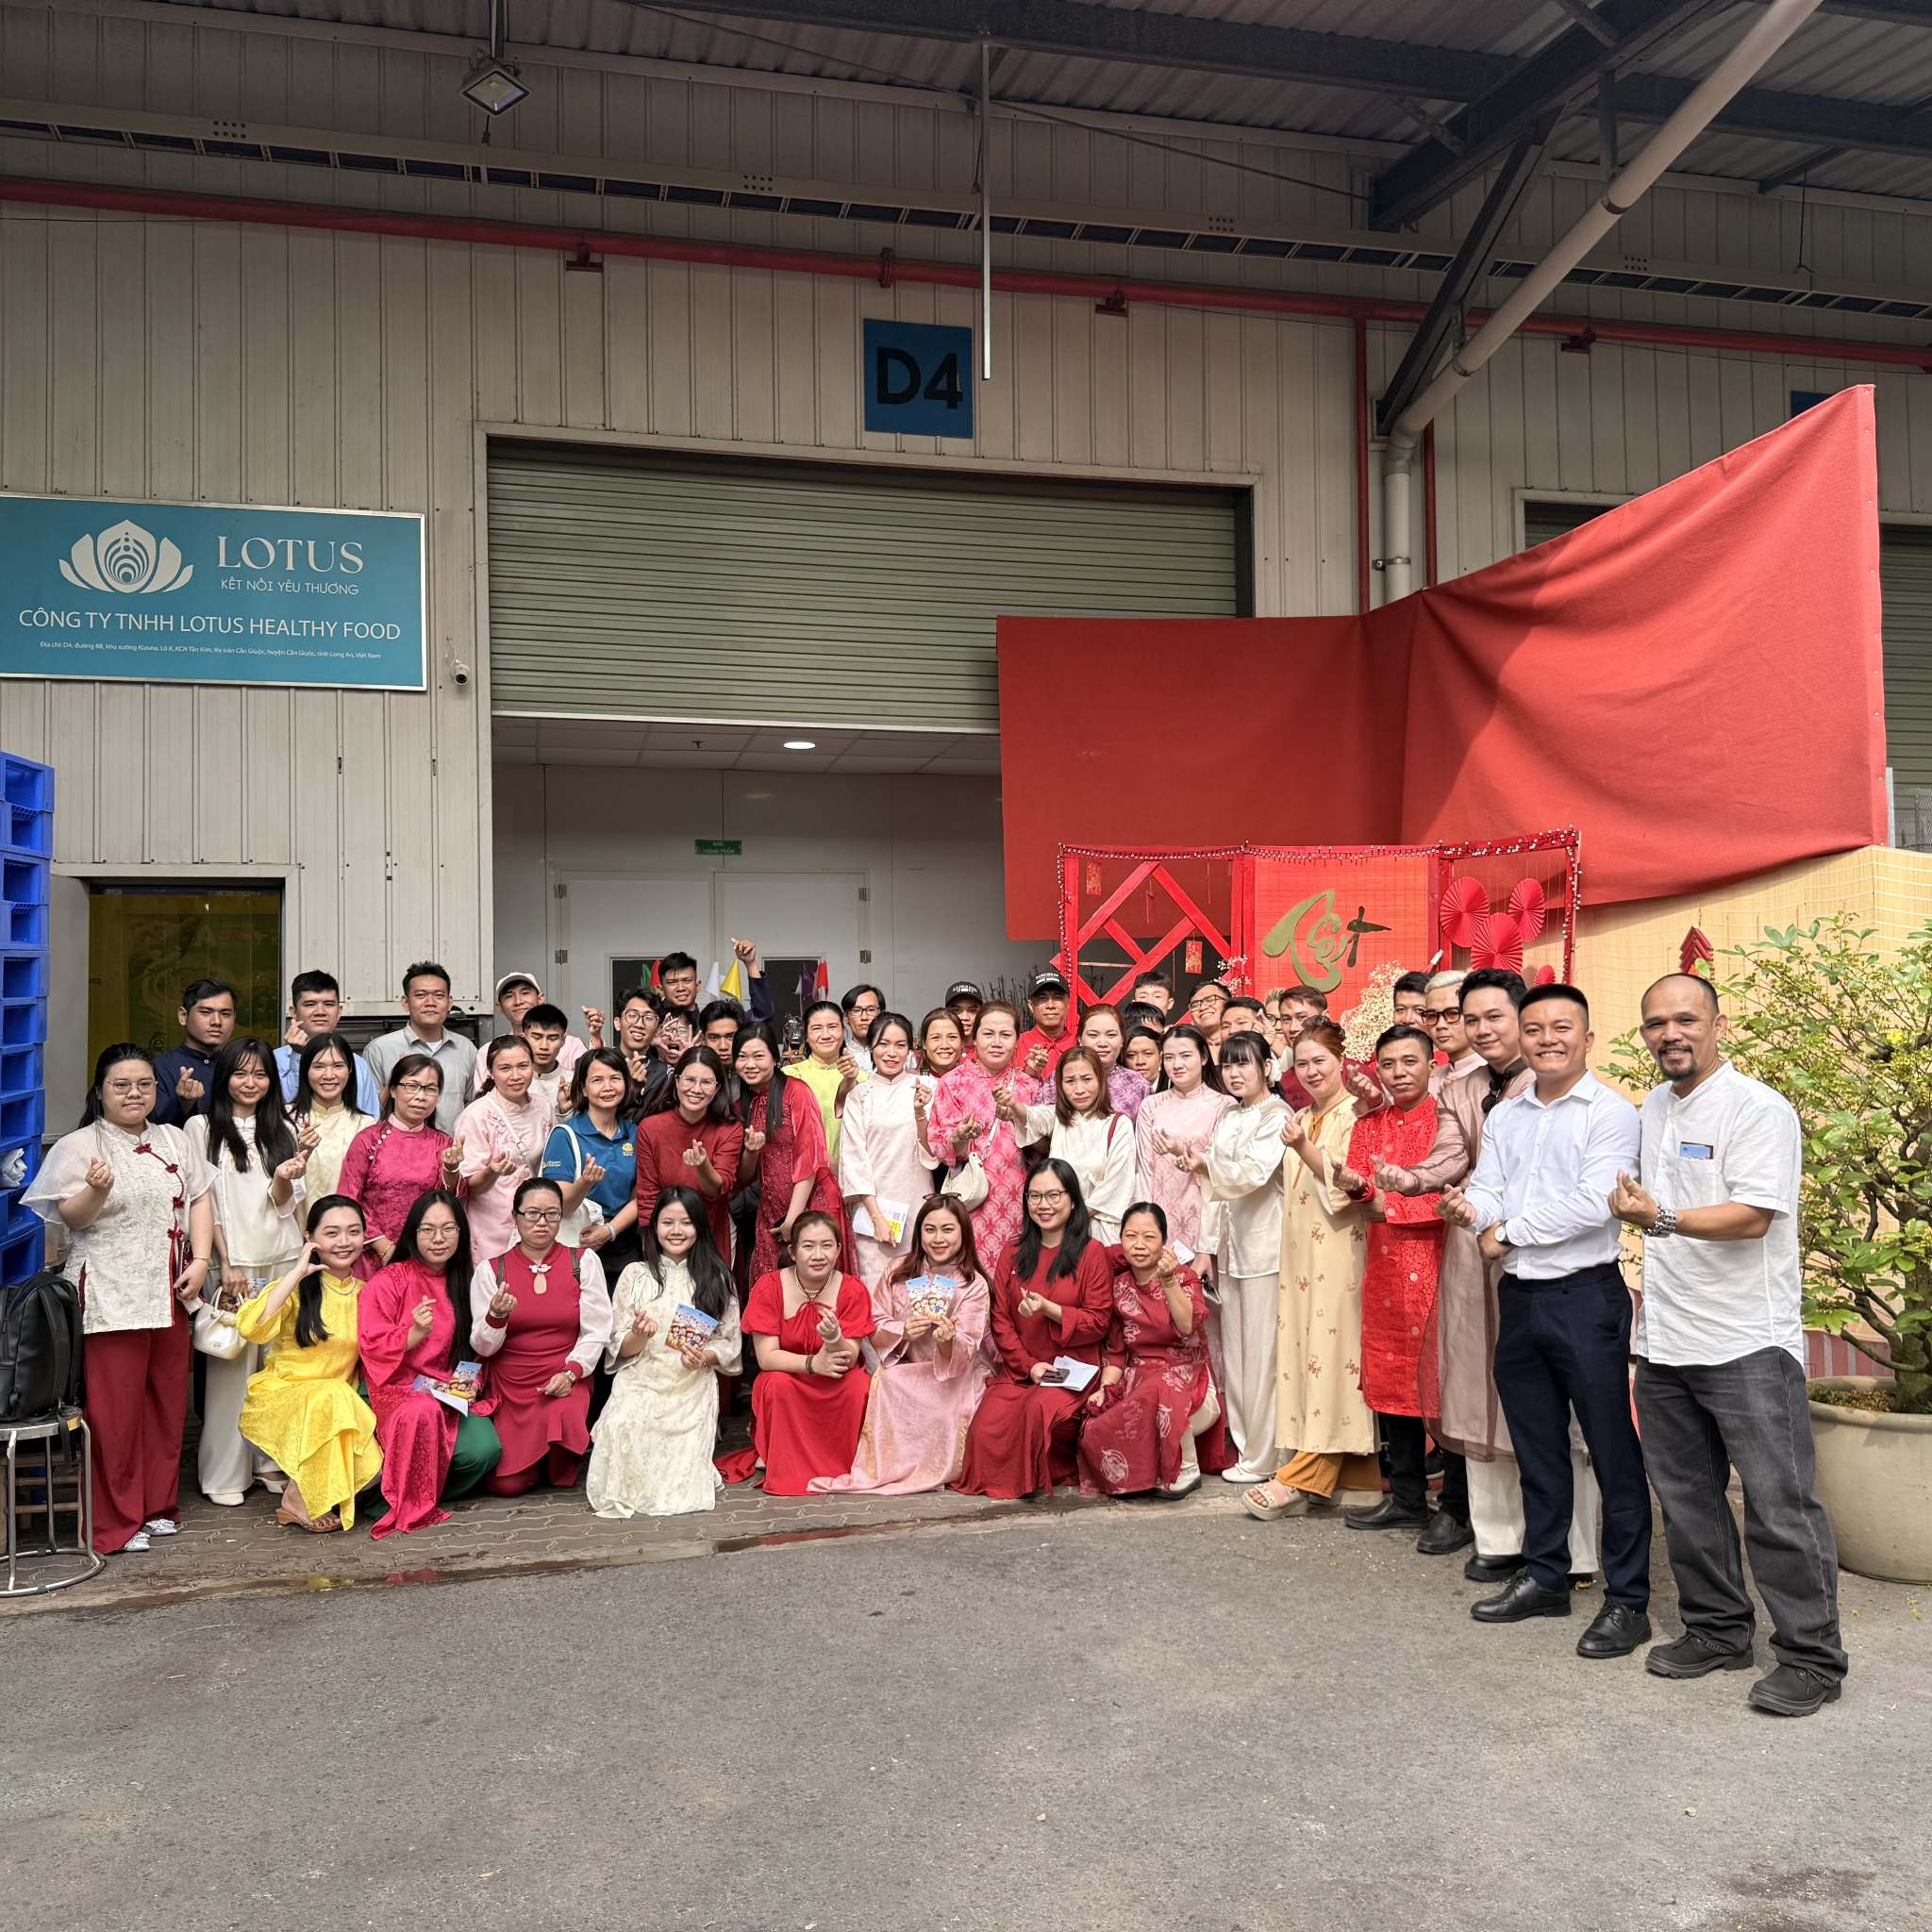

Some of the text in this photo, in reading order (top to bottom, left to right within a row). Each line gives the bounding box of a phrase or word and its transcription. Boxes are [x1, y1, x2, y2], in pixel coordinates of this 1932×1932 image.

[876, 346, 964, 410] D4
[217, 535, 364, 574] LOTUS
[277, 579, 301, 593] YÊU
[304, 581, 359, 595] THƯƠNG
[19, 607, 401, 640] CÔNG TY TNHH LOTUS HEALTHY FOOD
